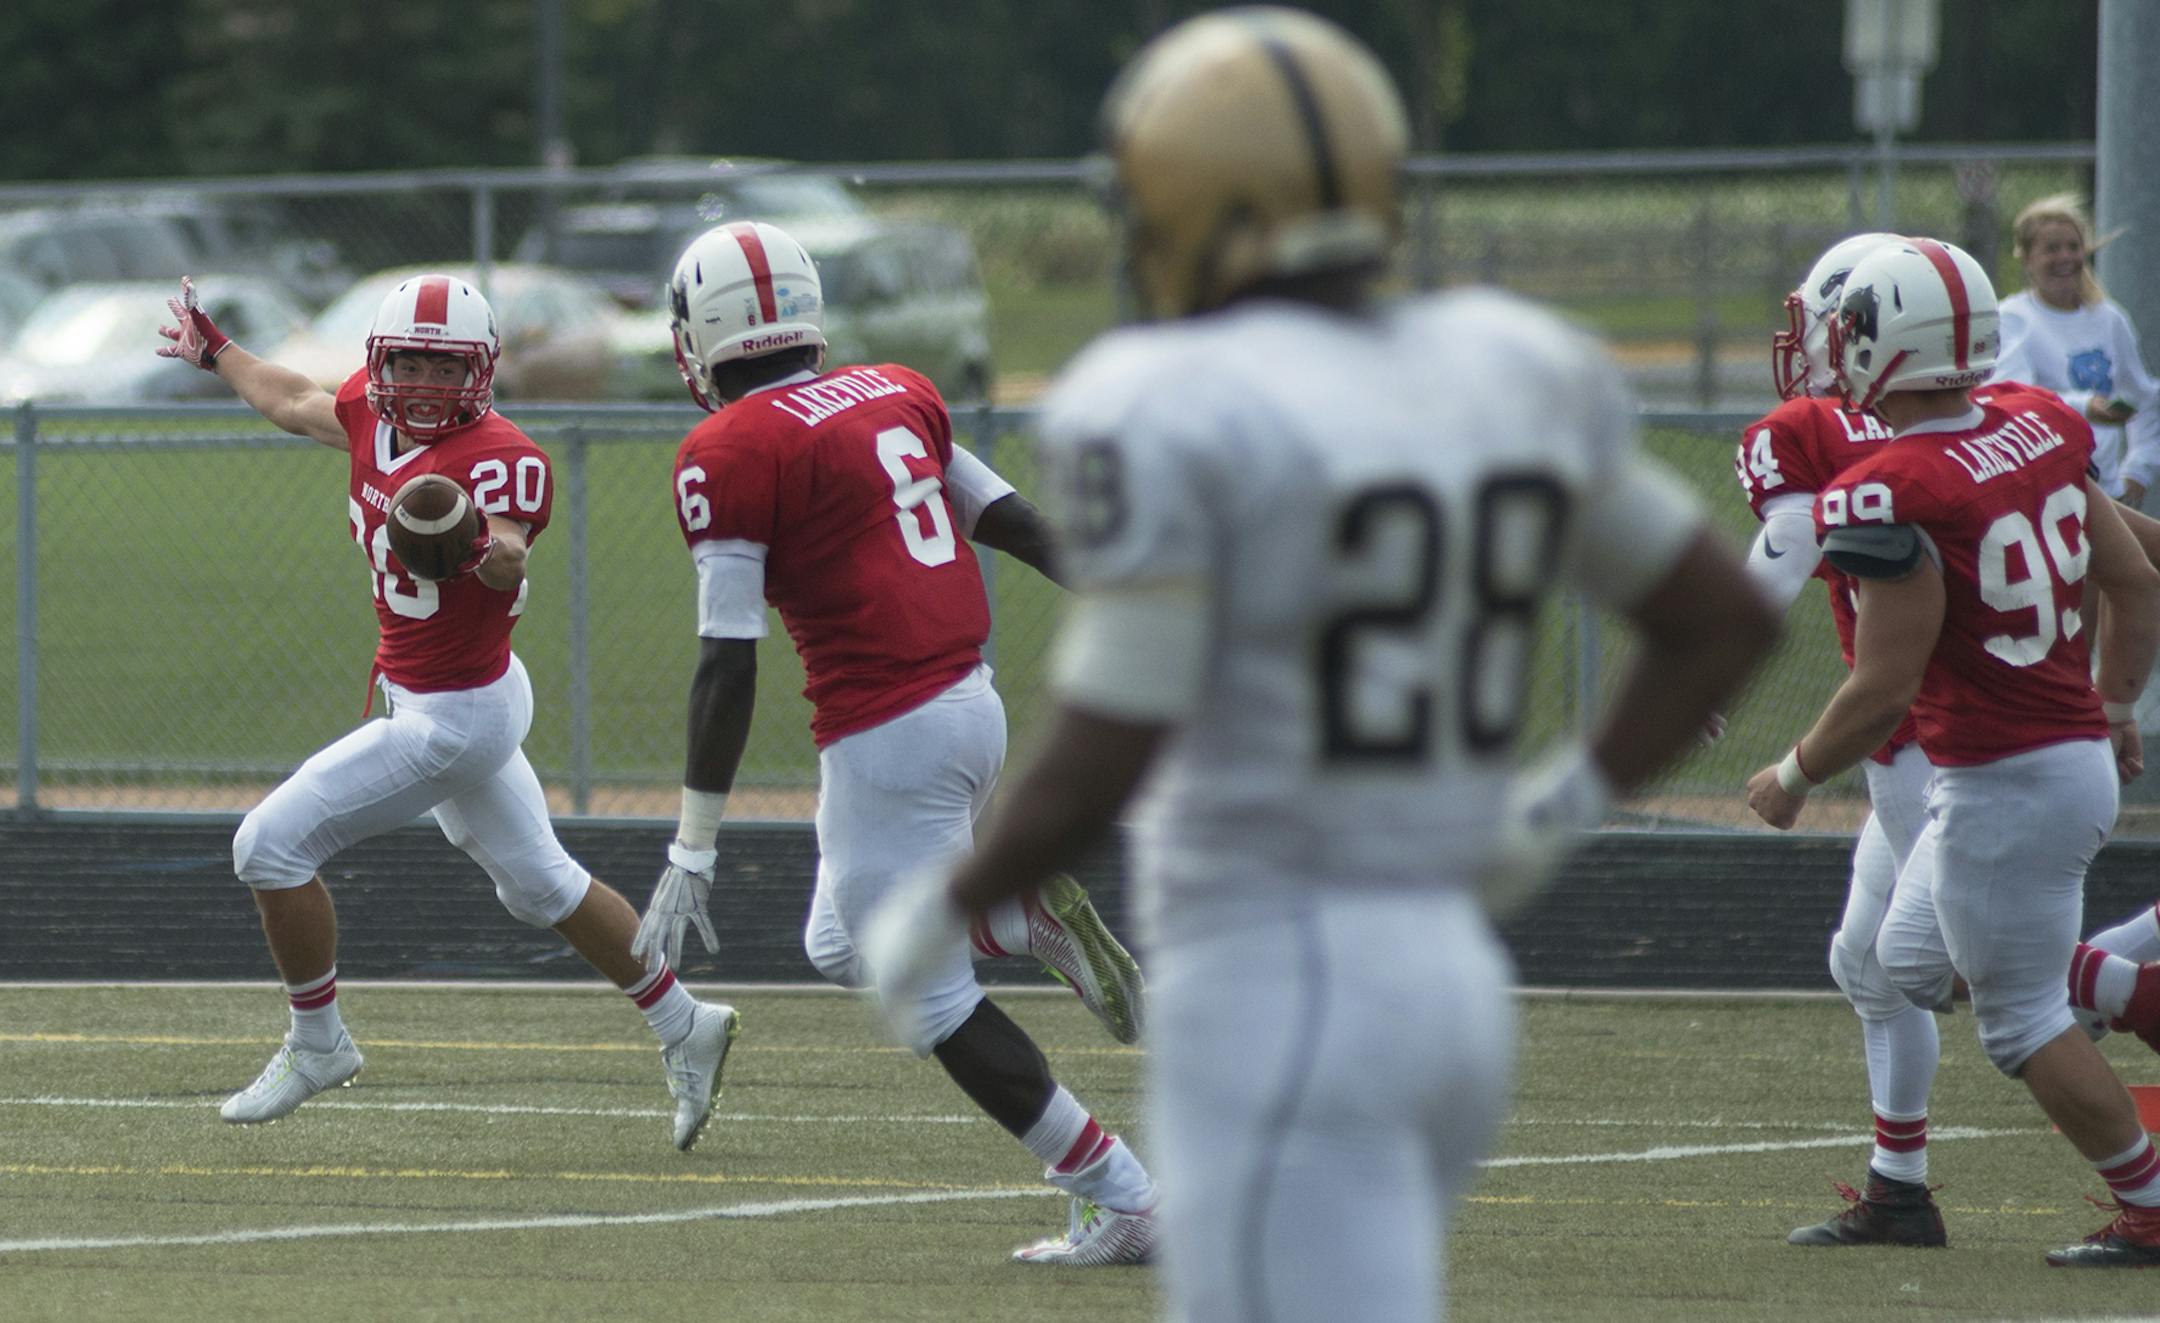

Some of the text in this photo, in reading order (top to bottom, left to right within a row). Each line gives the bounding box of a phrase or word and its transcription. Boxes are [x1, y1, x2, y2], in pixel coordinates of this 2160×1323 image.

[414, 326, 442, 336] NORTH
[742, 331, 804, 353] Riddell
[747, 314, 757, 327] 6
[771, 368, 907, 428] LAKEVILLE
[1944, 410, 2065, 484] LAKEVILLE
[360, 481, 392, 514] NORTH
[469, 456, 546, 514] 20
[677, 465, 711, 533] 6
[876, 425, 957, 568] 6
[1822, 483, 1895, 526] 99
[1978, 483, 2091, 668] 99
[1315, 465, 1572, 775] 28
